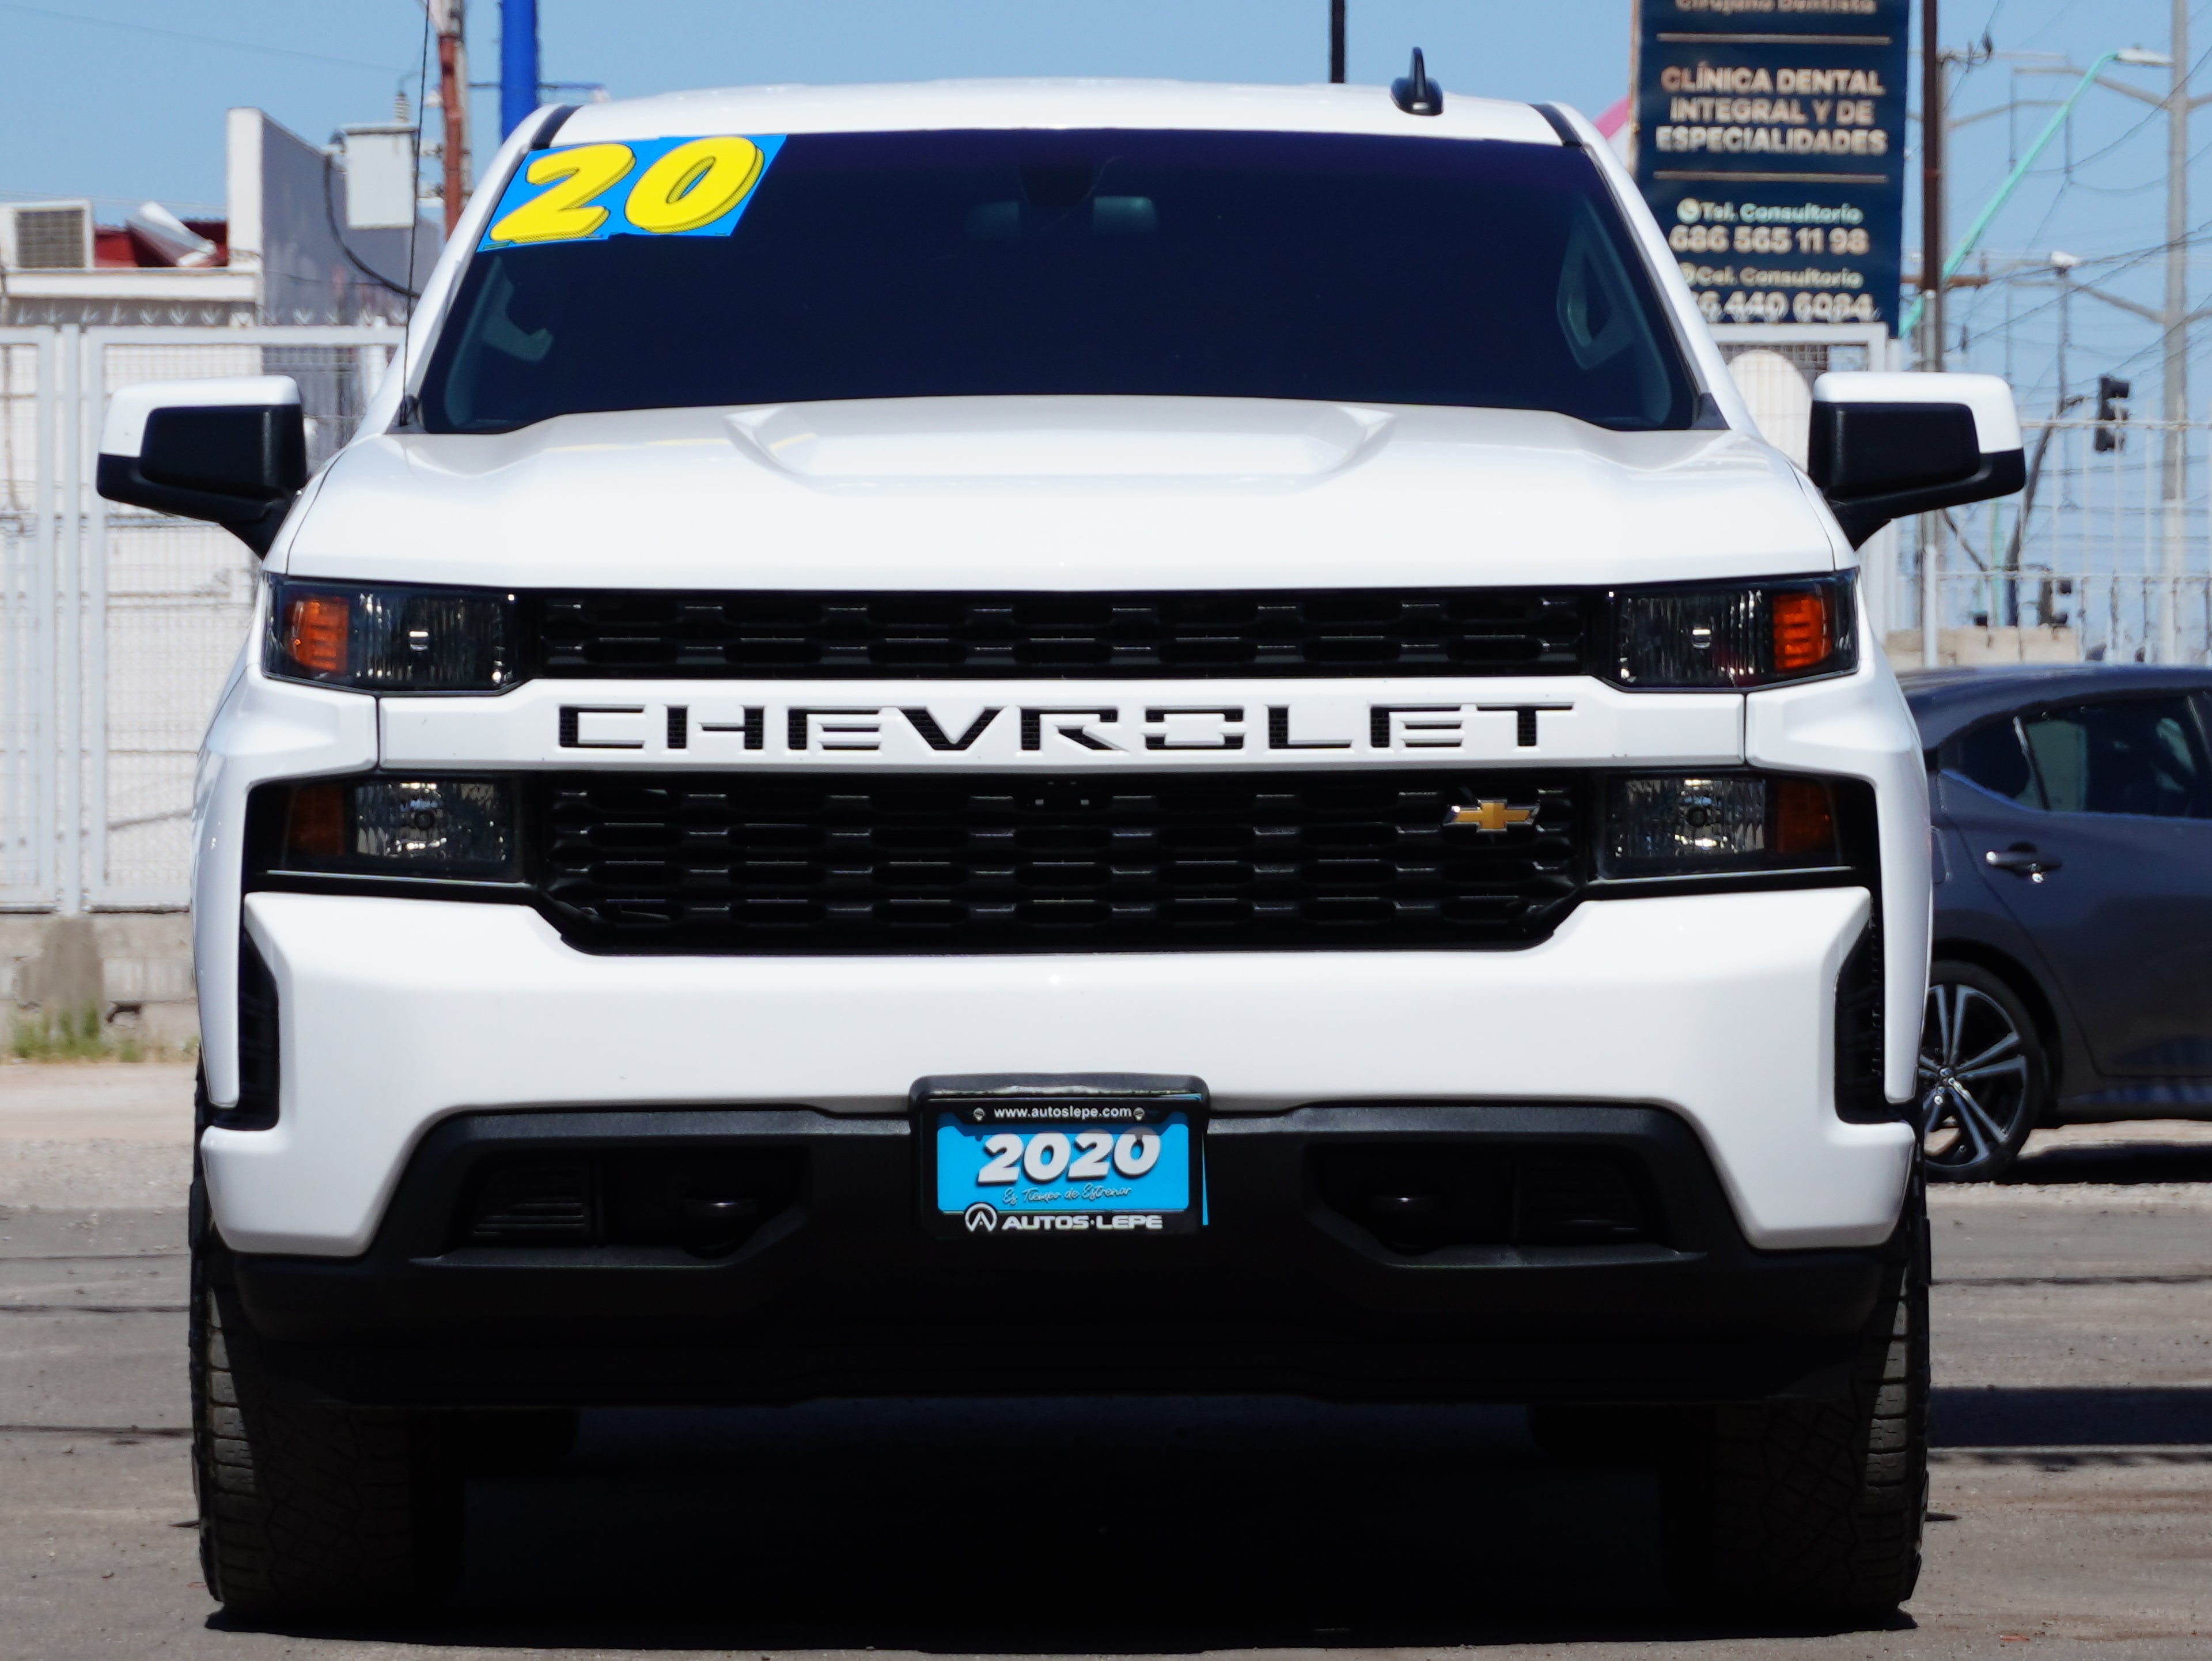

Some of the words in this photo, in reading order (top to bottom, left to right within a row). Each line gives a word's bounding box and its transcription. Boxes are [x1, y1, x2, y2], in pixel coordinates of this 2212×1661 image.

[1661, 60, 1772, 93] CLÍNICA
[1777, 67, 1885, 95] DENTAL
[1671, 96, 1808, 124] INTEGRAL
[1811, 99, 1832, 124] Y
[1836, 99, 1874, 125] DE
[1656, 126, 1889, 154] ESPECIALIDADES
[489, 136, 765, 244] 20
[1740, 203, 1864, 224] Consultorio
[1733, 225, 1793, 254] 565
[1796, 227, 1825, 255] 11
[1829, 227, 1869, 255] 98
[1739, 267, 1864, 289] Consultorio
[1724, 290, 1789, 323] 440
[1793, 292, 1877, 323] 6084
[559, 704, 1573, 751] CHEVROLET
[994, 1105, 1132, 1119] www.autoslepe.com
[977, 1127, 1161, 1186] 2020
[1002, 1187, 1018, 1205] Es
[1022, 1187, 1062, 1203] Tiempo
[1064, 1187, 1080, 1200] de
[1082, 1182, 1132, 1201] Estrenar
